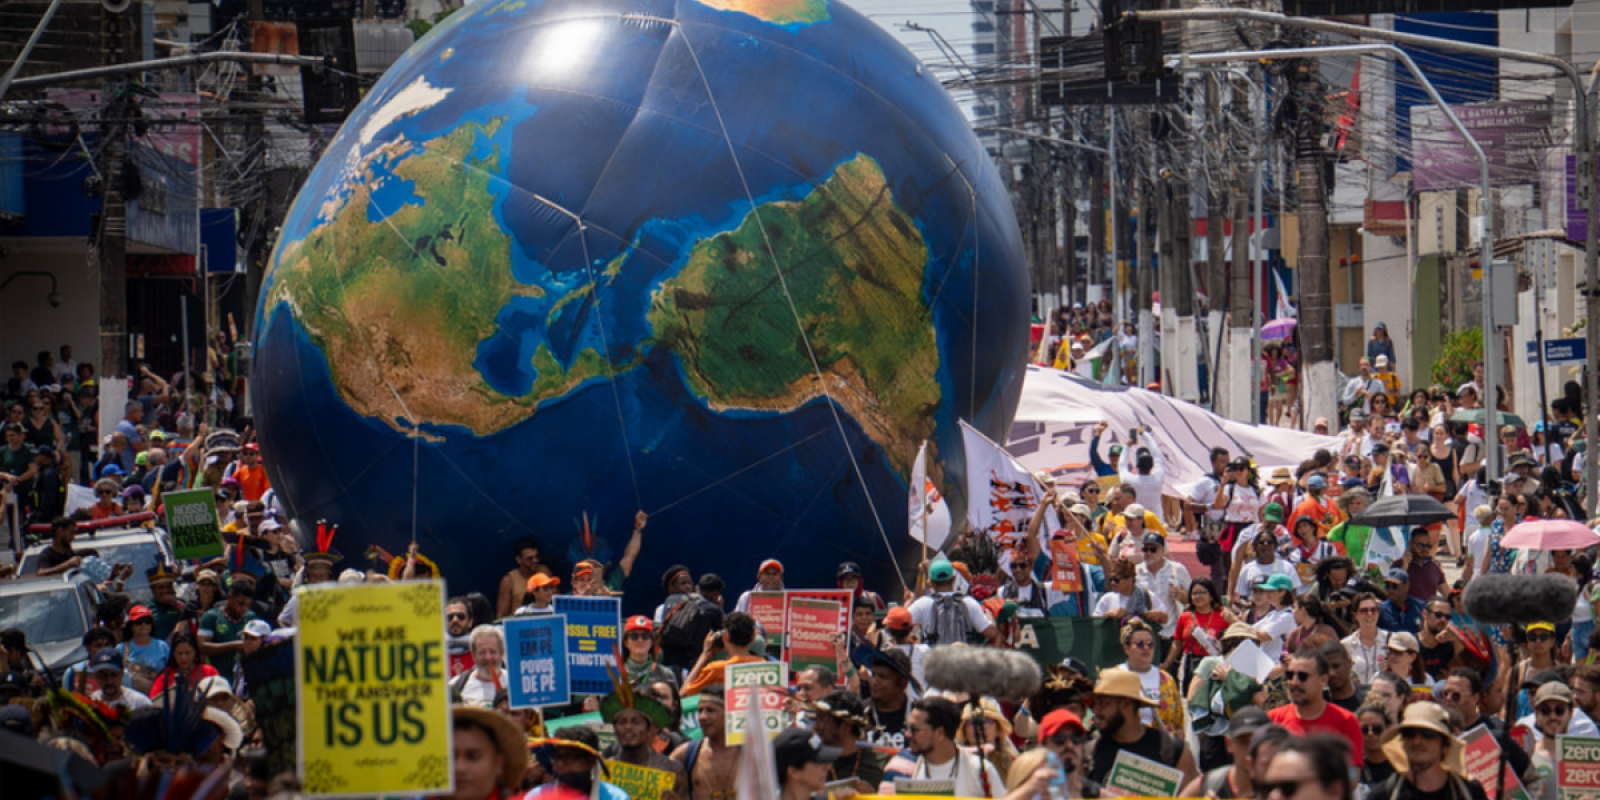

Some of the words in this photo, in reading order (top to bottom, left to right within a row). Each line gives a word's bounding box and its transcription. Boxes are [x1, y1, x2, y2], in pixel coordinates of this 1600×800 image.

[173, 502, 208, 515] NOSSO
[173, 512, 213, 527] FUTURO
[336, 628, 366, 642] WE
[373, 625, 406, 641] ARE
[592, 625, 617, 638] FREE
[520, 640, 538, 656] EM
[304, 641, 441, 684] NATURE
[520, 657, 554, 674] POVOS
[568, 653, 618, 667] TINCTION
[522, 674, 538, 693] DE
[735, 671, 777, 686] zero
[315, 686, 350, 700] THE
[355, 683, 433, 700] ANSWER
[325, 702, 363, 748] IS
[372, 699, 426, 745] US
